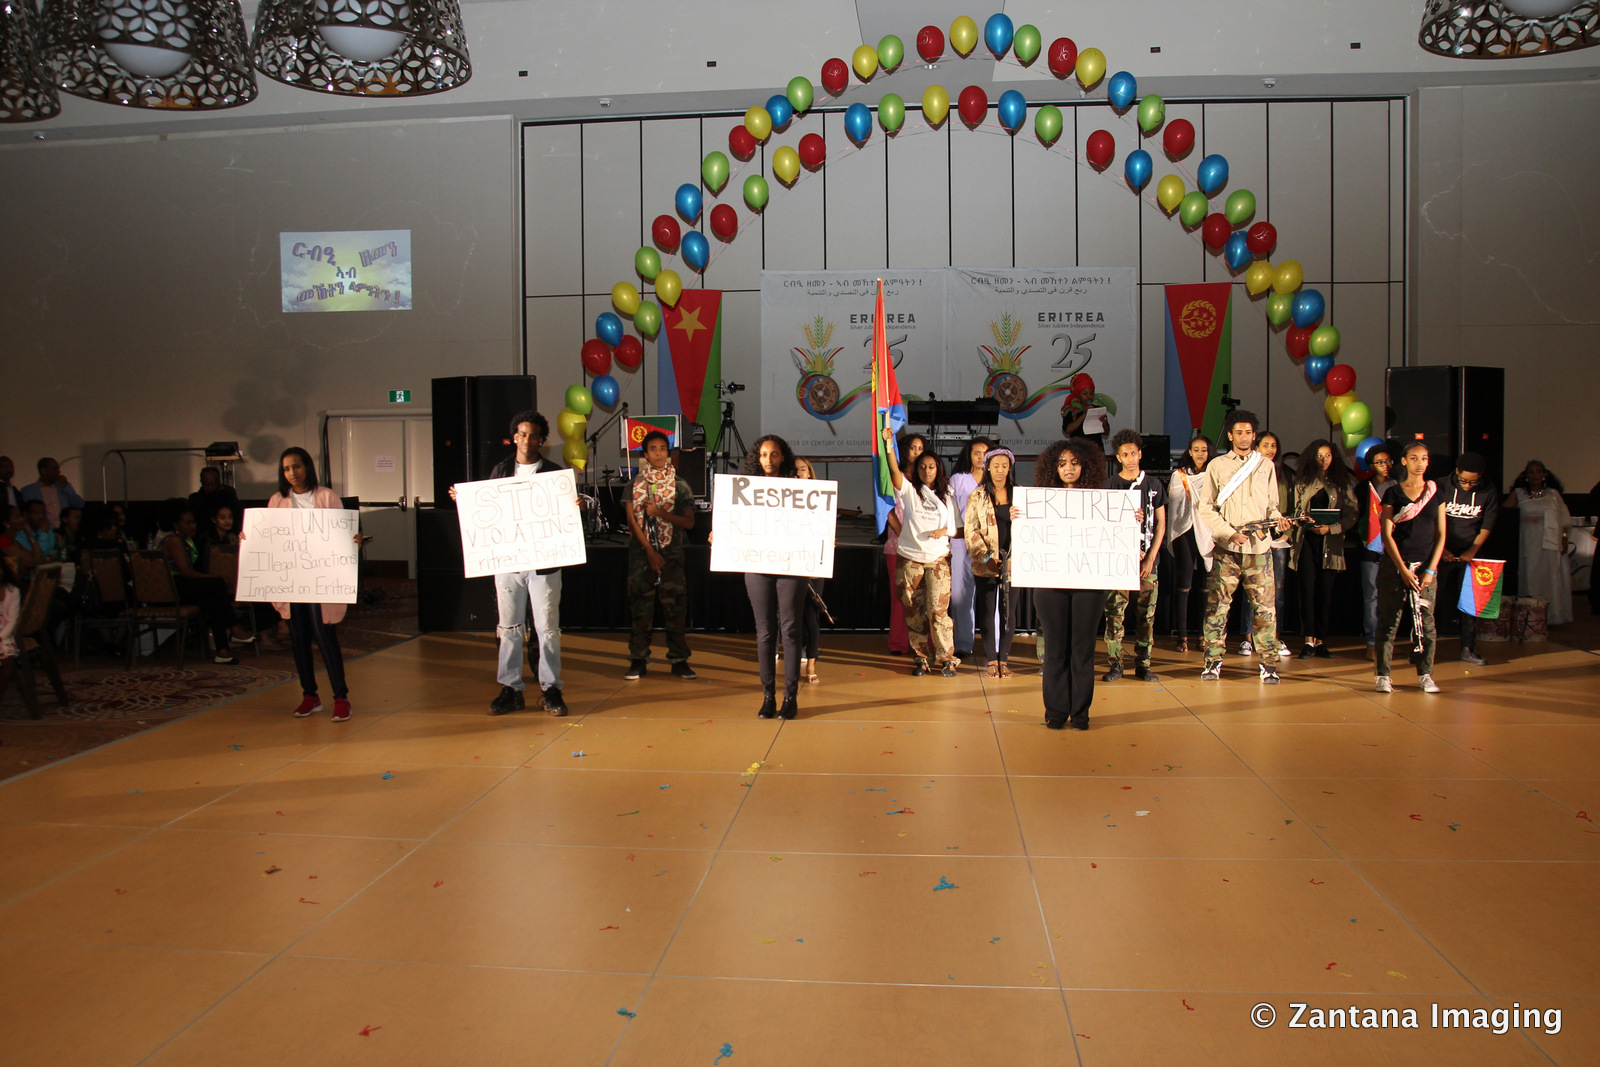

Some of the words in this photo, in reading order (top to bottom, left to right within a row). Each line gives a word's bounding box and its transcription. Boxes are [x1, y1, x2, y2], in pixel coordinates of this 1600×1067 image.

[850, 313, 916, 324] ERIREA
[1037, 312, 1105, 322] ERITREA
[1051, 333, 1096, 371] 25
[472, 474, 573, 529] STOP
[1025, 488, 1139, 524] ERITREA
[252, 510, 295, 544] Repeal
[466, 514, 579, 548] VIOLATING
[1020, 525, 1059, 546] ONE
[1070, 525, 1138, 550] HEART
[282, 535, 309, 553] and
[248, 551, 298, 582] Illegal
[300, 550, 358, 570] Sanctions
[467, 548, 531, 574] Eritrea's
[1020, 551, 1060, 573] ONE
[1067, 551, 1138, 577] NATION
[242, 576, 294, 600] Imposed
[298, 585, 311, 595] on
[315, 575, 357, 596] Eritrea
